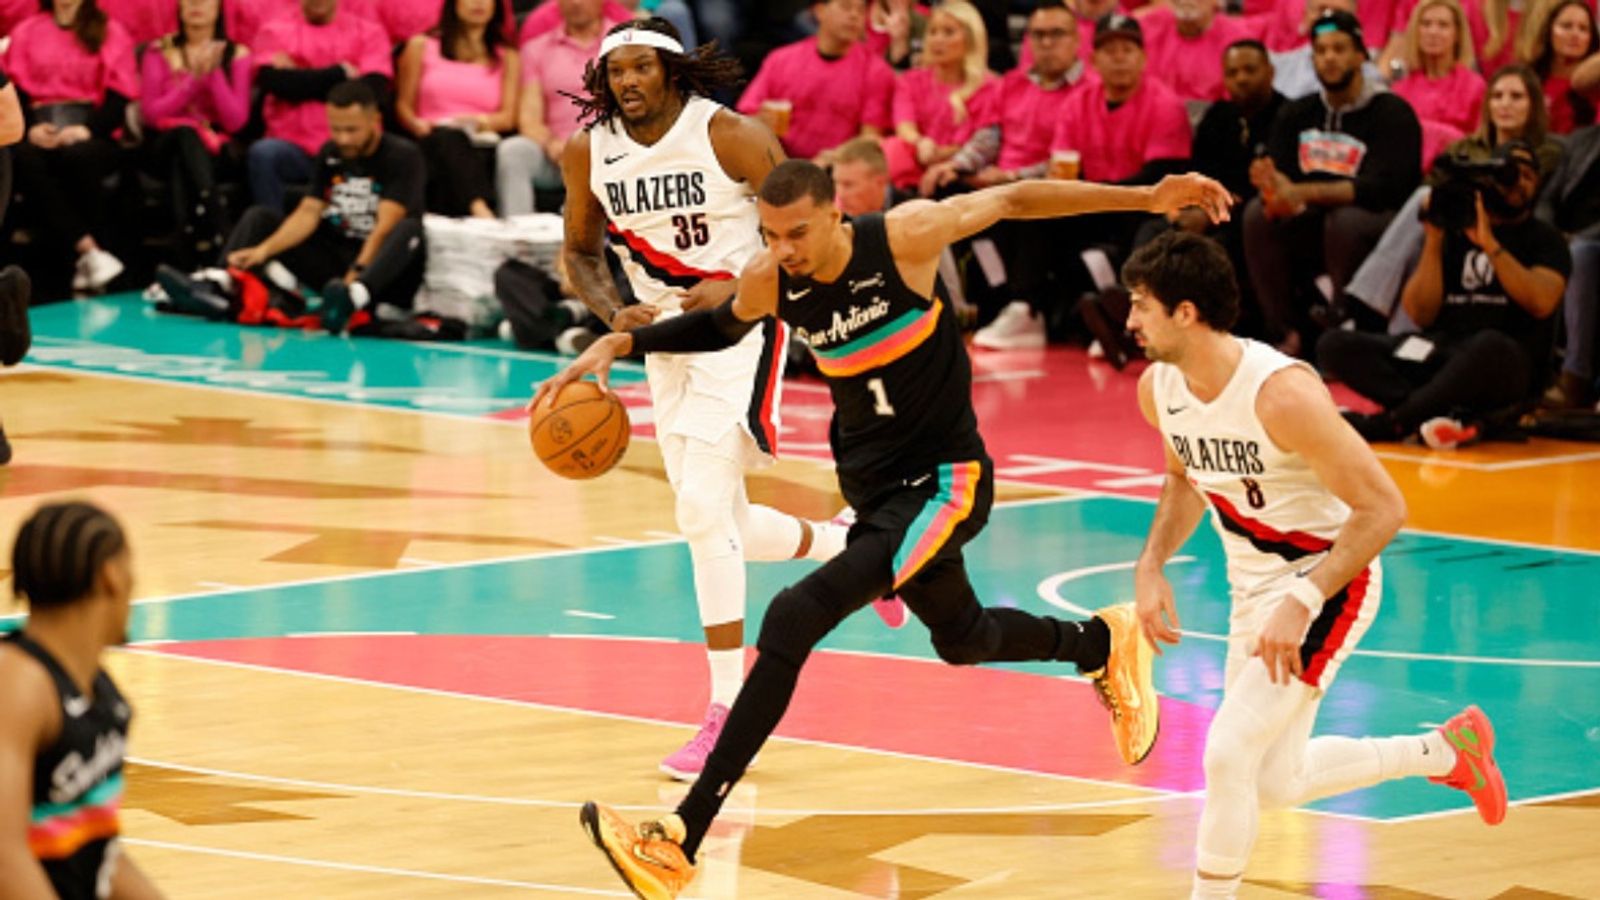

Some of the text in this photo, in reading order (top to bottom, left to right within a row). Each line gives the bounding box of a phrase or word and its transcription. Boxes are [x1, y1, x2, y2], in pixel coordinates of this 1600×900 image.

[604, 171, 706, 217] BLAZERS
[671, 212, 709, 251] 35
[827, 296, 890, 342] Antonio
[867, 377, 895, 416] 1
[1169, 433, 1265, 475] BLAZERS
[1240, 477, 1266, 510] 8
